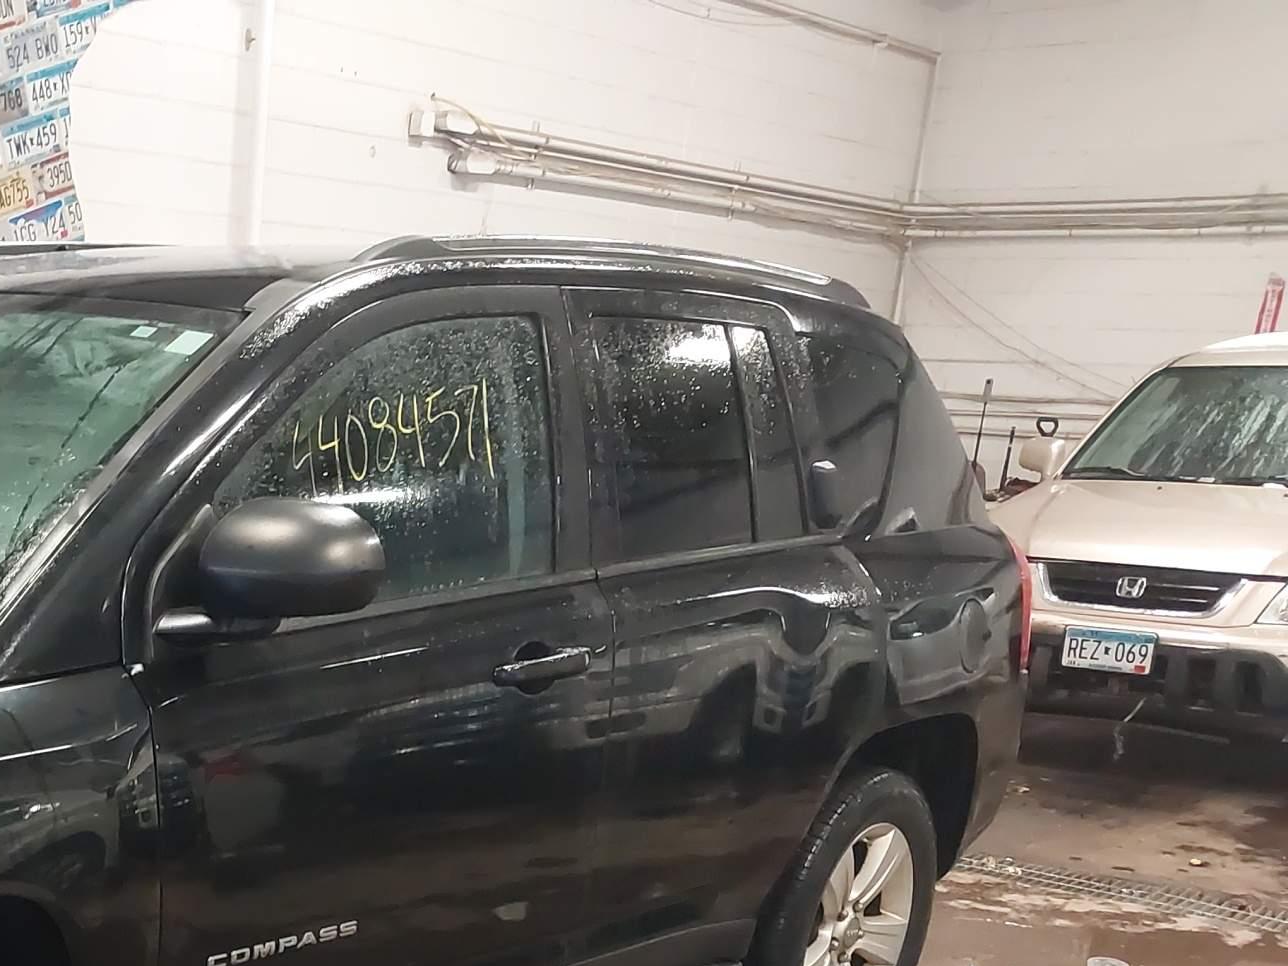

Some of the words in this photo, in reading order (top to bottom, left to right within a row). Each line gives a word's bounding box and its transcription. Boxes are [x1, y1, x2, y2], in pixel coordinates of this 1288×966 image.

[292, 377, 495, 497] 44084571
[1067, 638, 1103, 661] REZ
[1114, 642, 1149, 665] 069
